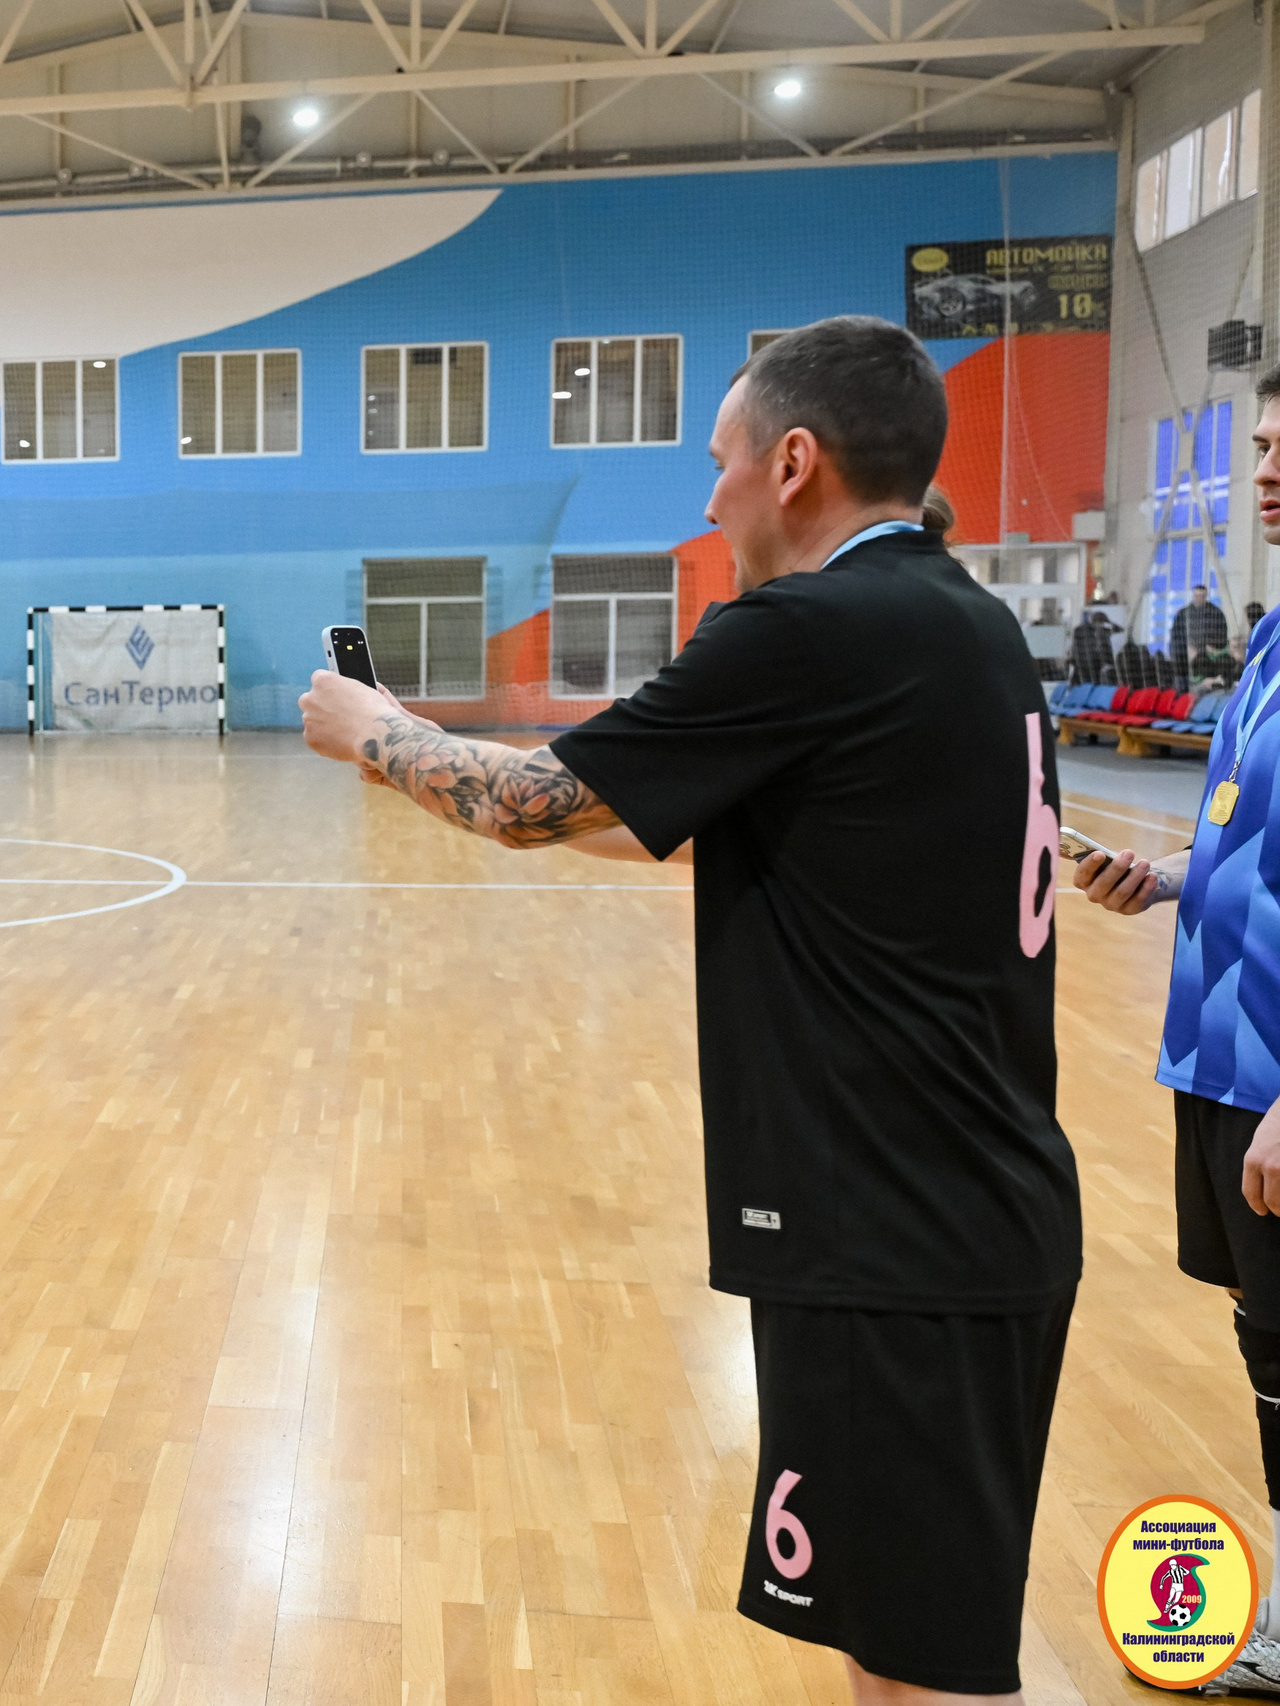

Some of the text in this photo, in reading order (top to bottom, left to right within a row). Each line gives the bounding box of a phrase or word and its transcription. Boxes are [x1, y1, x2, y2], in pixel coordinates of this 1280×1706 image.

[985, 241, 1107, 266] АВТОМОЙКА
[64, 679, 218, 714] СанТермо
[1019, 712, 1061, 958] 6
[765, 1469, 813, 1580] 6
